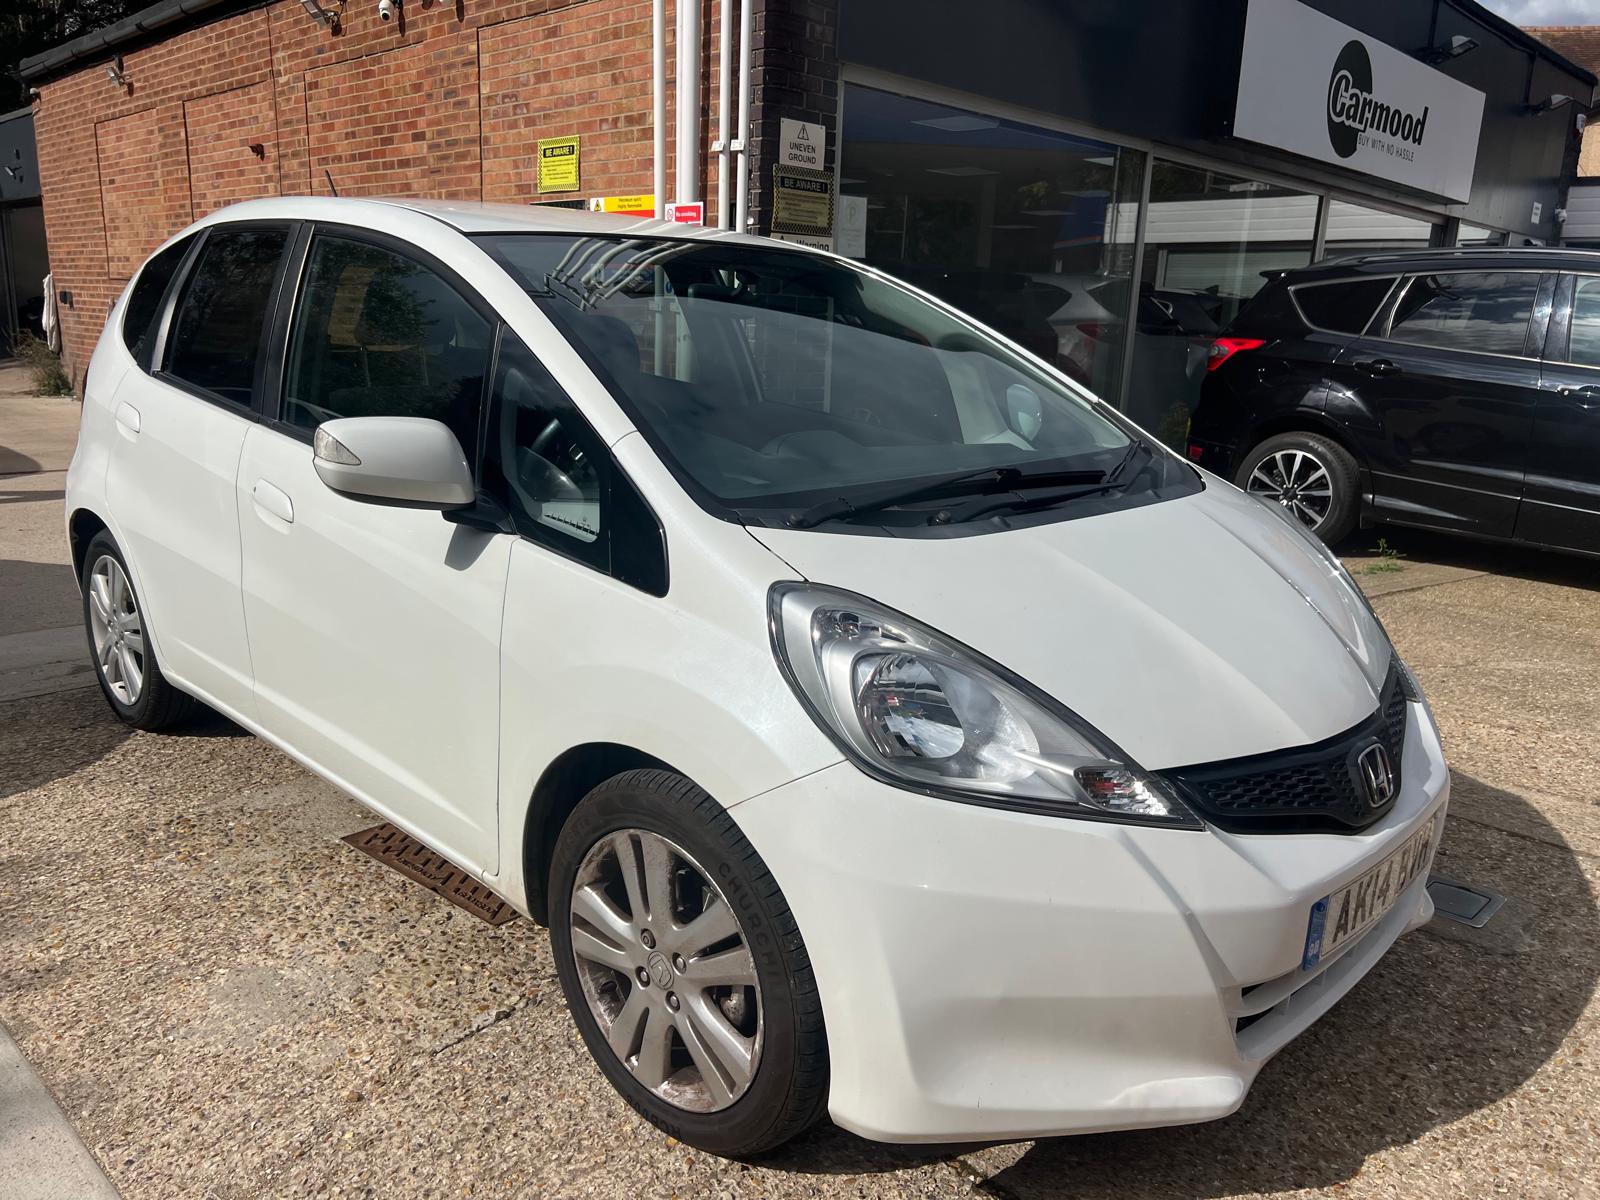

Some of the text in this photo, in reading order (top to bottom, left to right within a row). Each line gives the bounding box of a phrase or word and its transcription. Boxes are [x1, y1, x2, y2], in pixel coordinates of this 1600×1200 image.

[1330, 74, 1429, 146] Carmood
[545, 148, 553, 157] BE
[789, 141, 816, 154] UNEVEN
[1358, 133, 1415, 162] BUY WITH NO HASSLE
[788, 152, 817, 165] GROUND
[784, 177, 795, 188] BE
[1332, 858, 1394, 944] AK14
